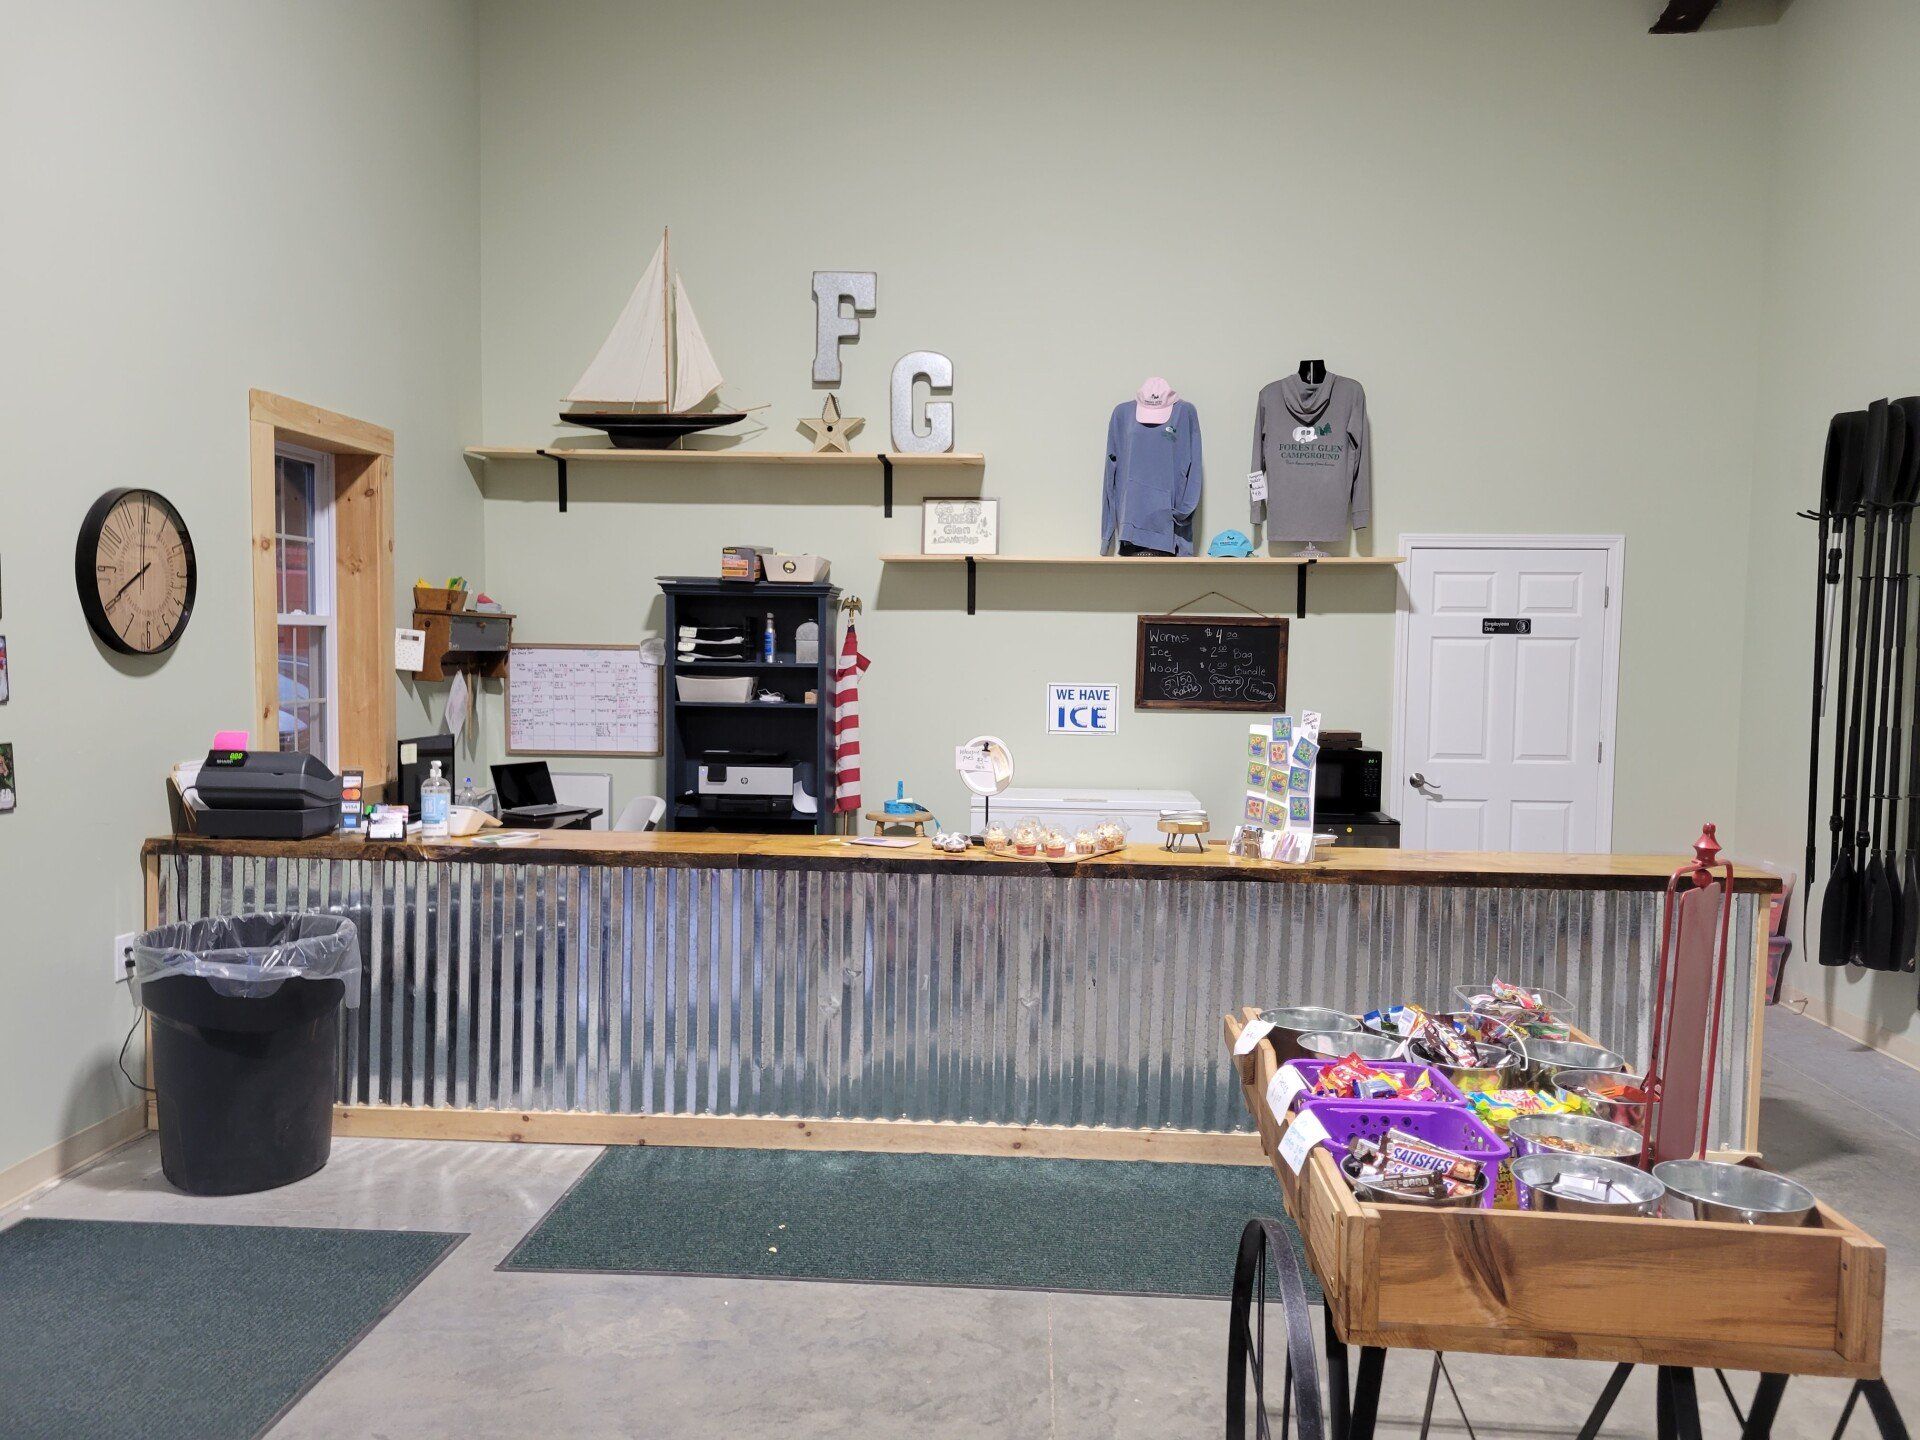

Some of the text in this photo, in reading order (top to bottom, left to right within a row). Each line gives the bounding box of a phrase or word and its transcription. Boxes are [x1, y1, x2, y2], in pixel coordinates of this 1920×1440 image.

[812, 271, 876, 383] F
[890, 350, 953, 453] G
[1279, 443, 1343, 453] FOREST GLEN
[1280, 452, 1340, 460] CAMPGROUND
[1149, 628, 1189, 642] Worms
[1150, 645, 1171, 657] Ice
[1150, 662, 1179, 673] Wood
[1233, 665, 1266, 676] Bundle
[1056, 689, 1111, 700] WE HAVE
[1057, 705, 1107, 728] ICE
[1393, 1147, 1453, 1175] SATISFIES
